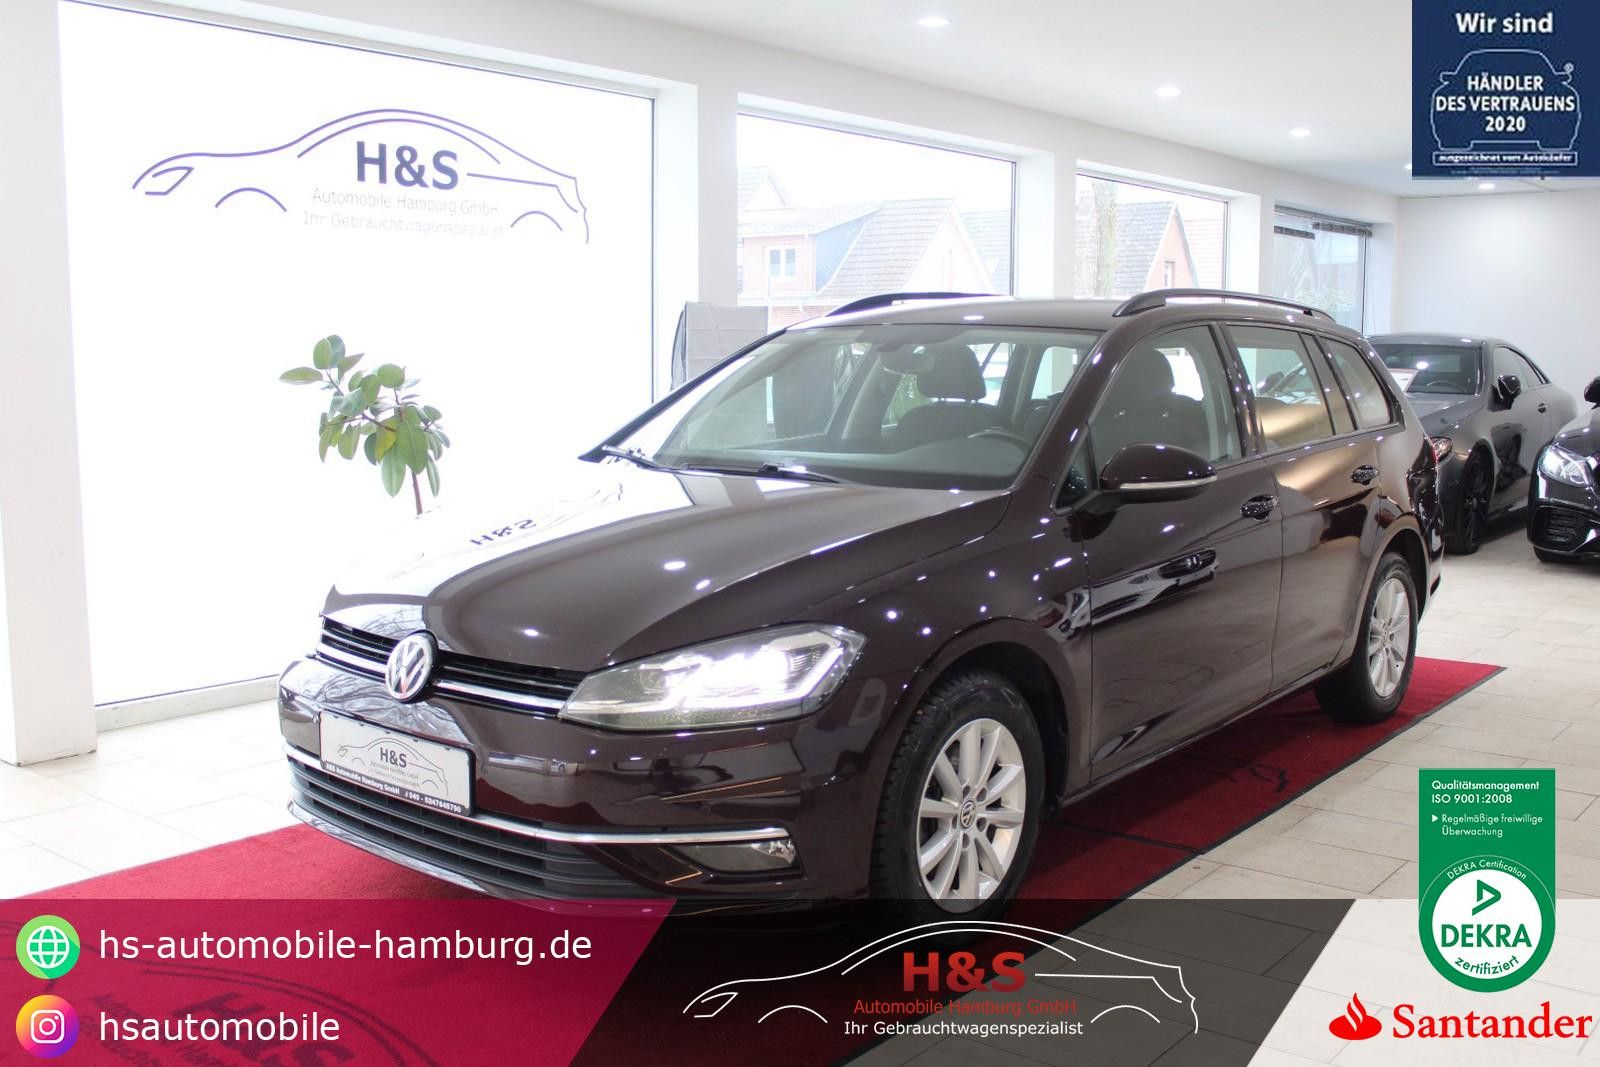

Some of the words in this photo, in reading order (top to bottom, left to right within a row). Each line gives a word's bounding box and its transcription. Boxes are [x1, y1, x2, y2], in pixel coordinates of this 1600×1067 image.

[356, 140, 459, 191] H&S
[312, 187, 392, 209] Automobile
[396, 194, 457, 216] Hamburg
[303, 210, 327, 226] Ihr
[379, 746, 407, 768] H&S
